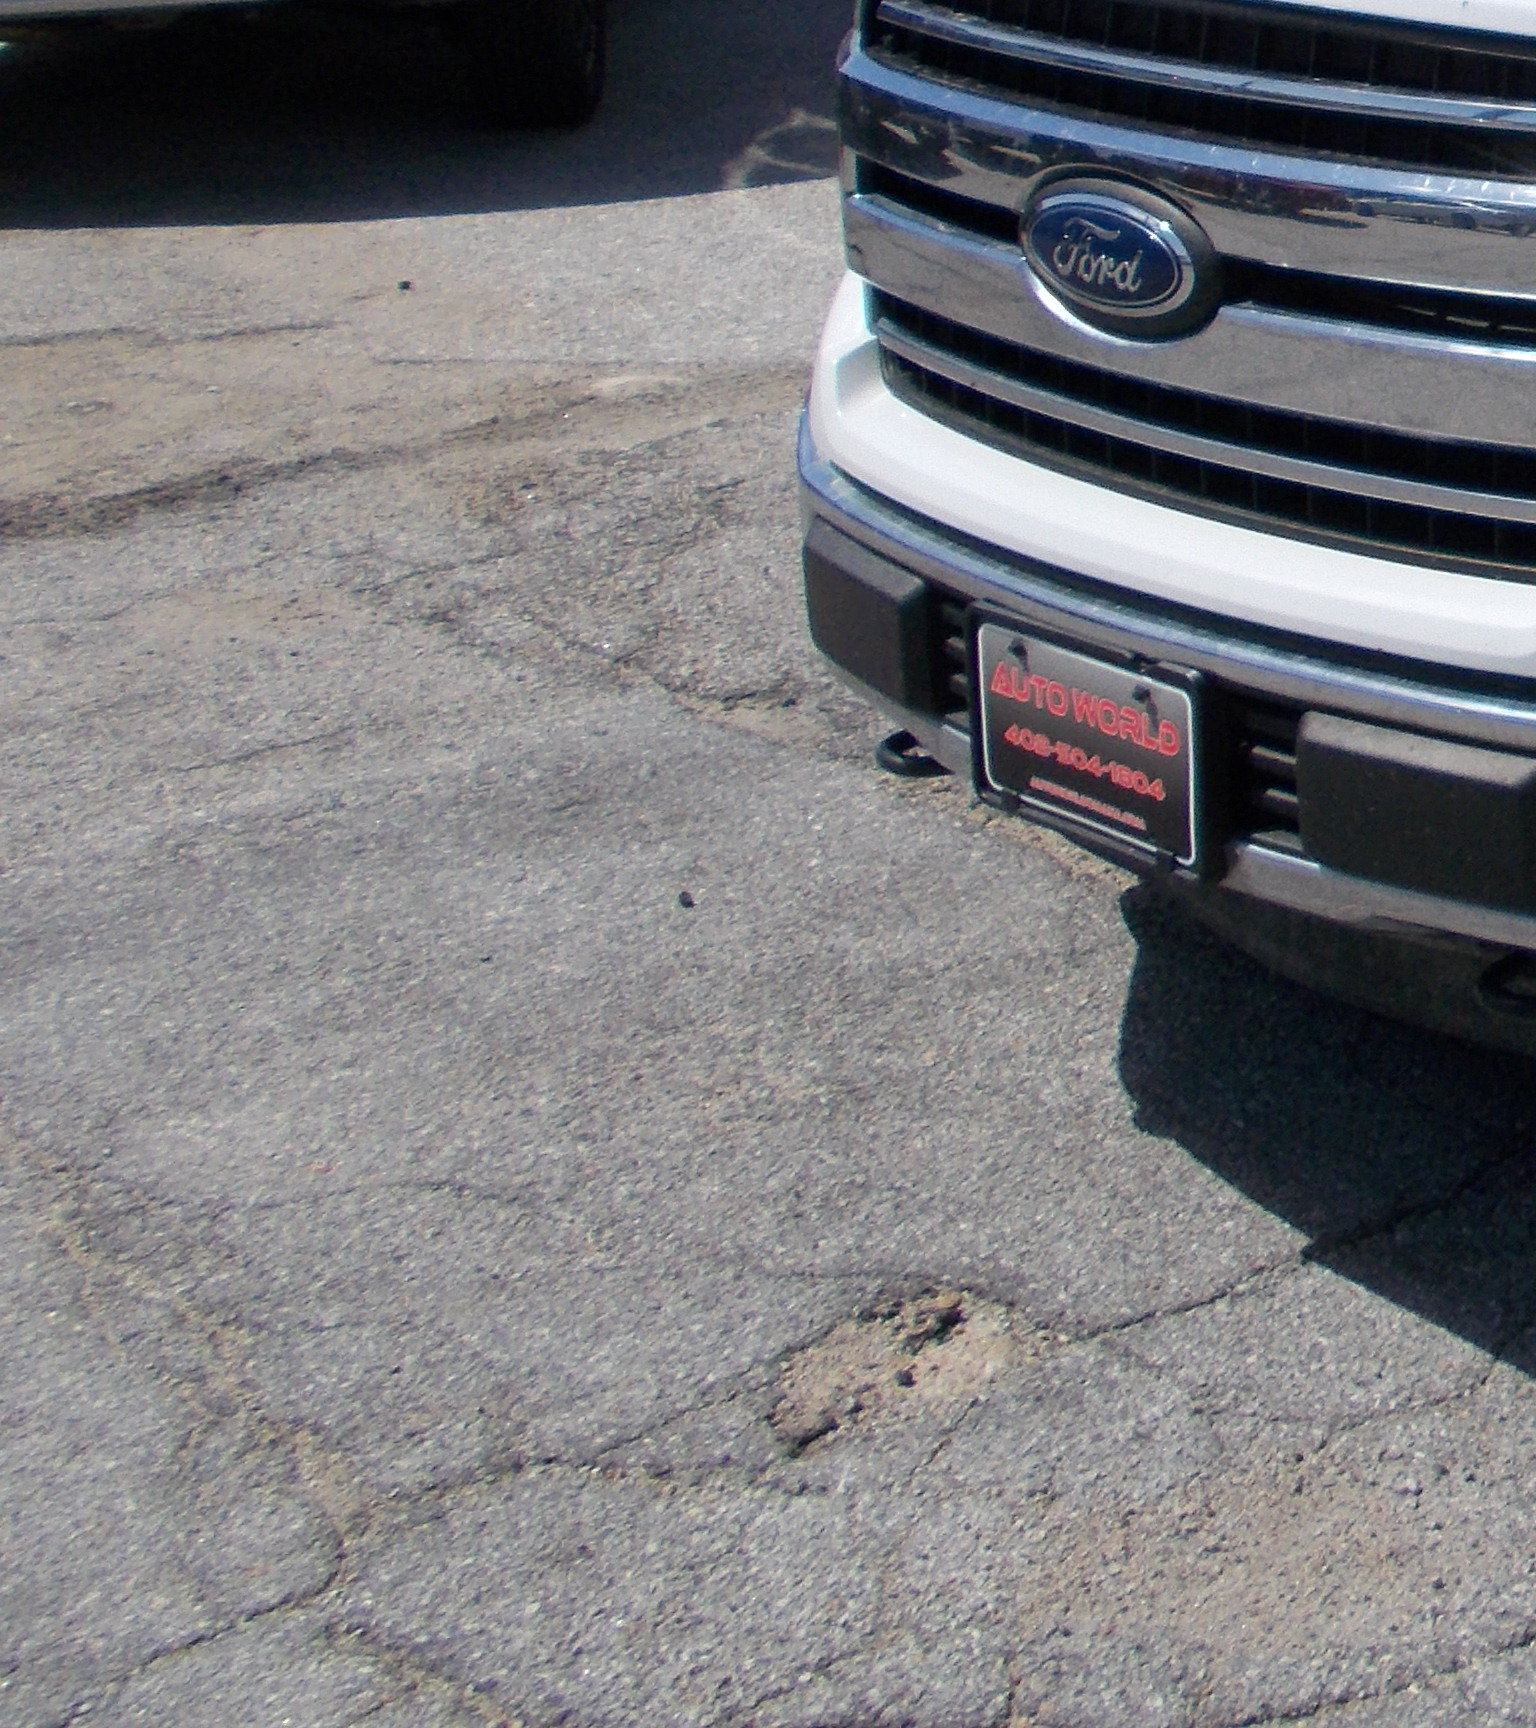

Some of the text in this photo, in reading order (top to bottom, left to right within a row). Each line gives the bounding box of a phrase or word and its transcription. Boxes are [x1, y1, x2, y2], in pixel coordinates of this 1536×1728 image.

[1053, 217, 1142, 293] Ford
[991, 661, 1182, 756] AUTO WORLD
